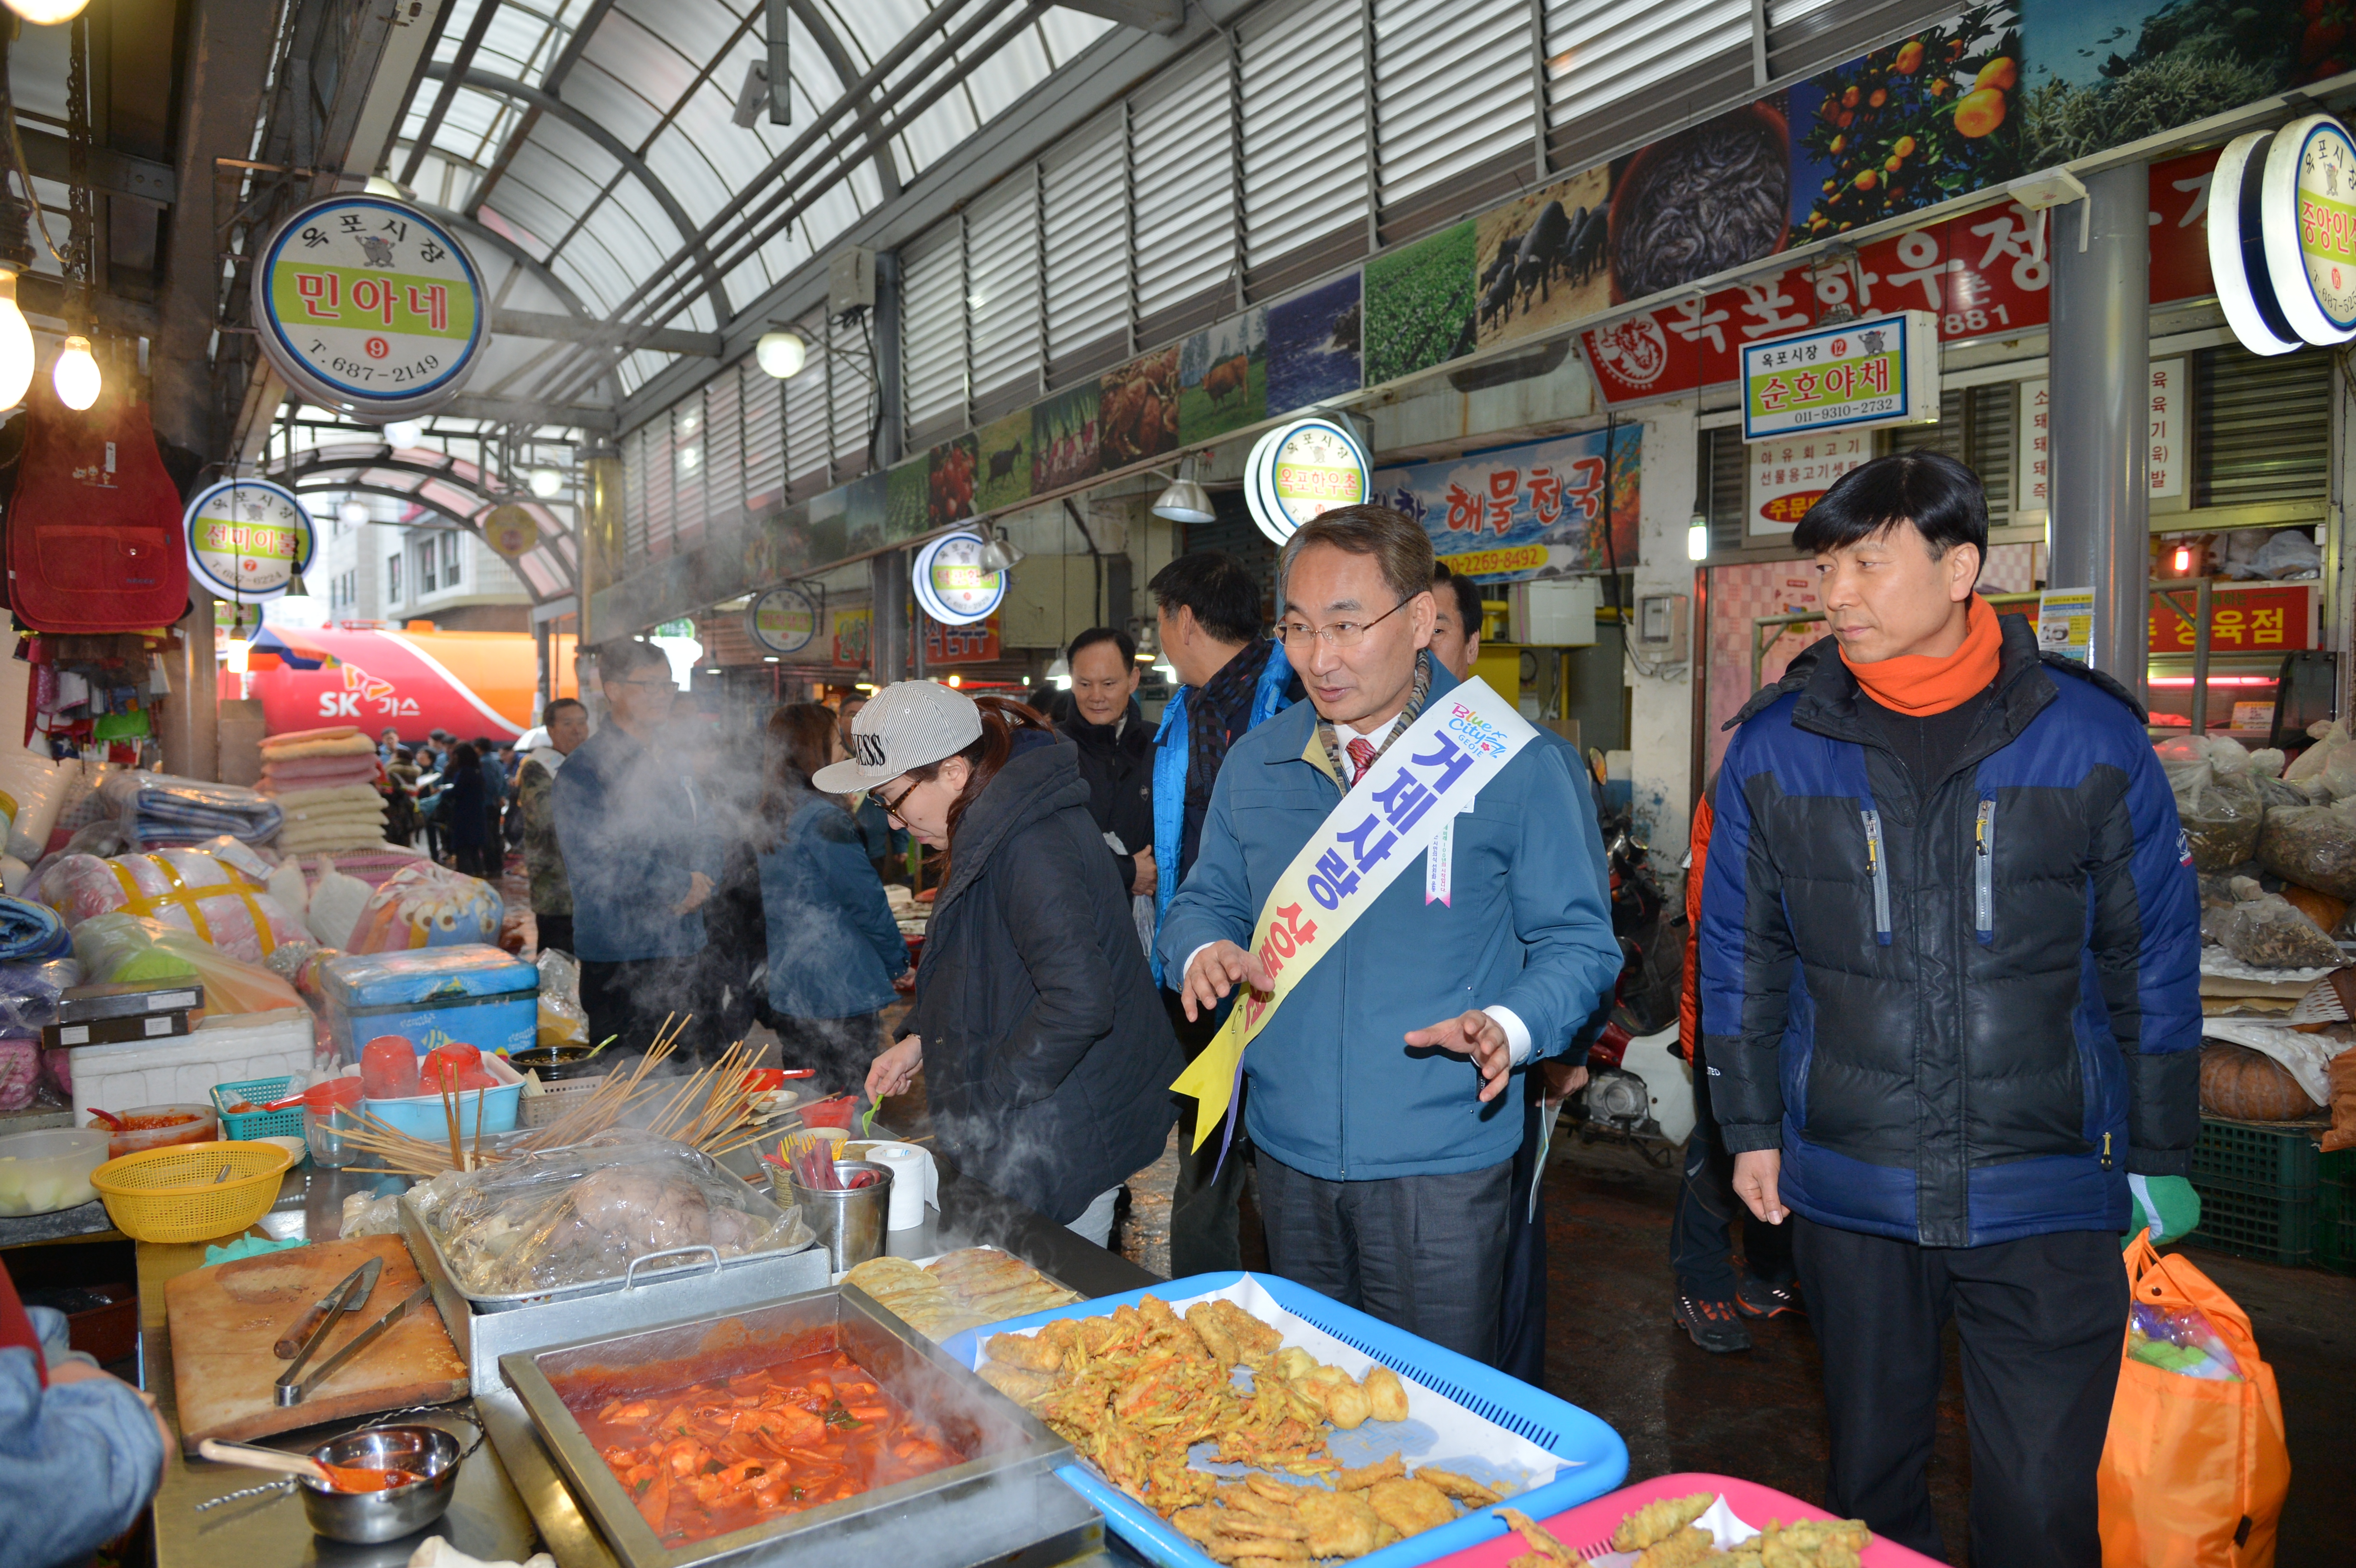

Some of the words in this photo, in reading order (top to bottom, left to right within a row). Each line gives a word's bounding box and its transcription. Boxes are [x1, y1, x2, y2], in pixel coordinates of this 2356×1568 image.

[302, 214, 447, 264] 옥포시장
[294, 272, 448, 331] 민아네
[1762, 345, 1818, 368] 옥포시장
[1759, 358, 1889, 411] 순호야채
[1794, 398, 1893, 424] 011-9310-2732
[1287, 433, 1348, 459] 옥포시장
[1278, 468, 1358, 497] 옥포한우촌
[1446, 456, 1605, 535] 해물천국
[213, 492, 294, 519] 옥포시장
[206, 523, 297, 557] 선미이불
[318, 691, 362, 718] SK
[377, 697, 421, 718] 가스
[1452, 702, 1492, 732] Blue
[1449, 718, 1486, 744] City
[1458, 734, 1484, 758] GEOJE
[1307, 730, 1475, 910] 거제사랑
